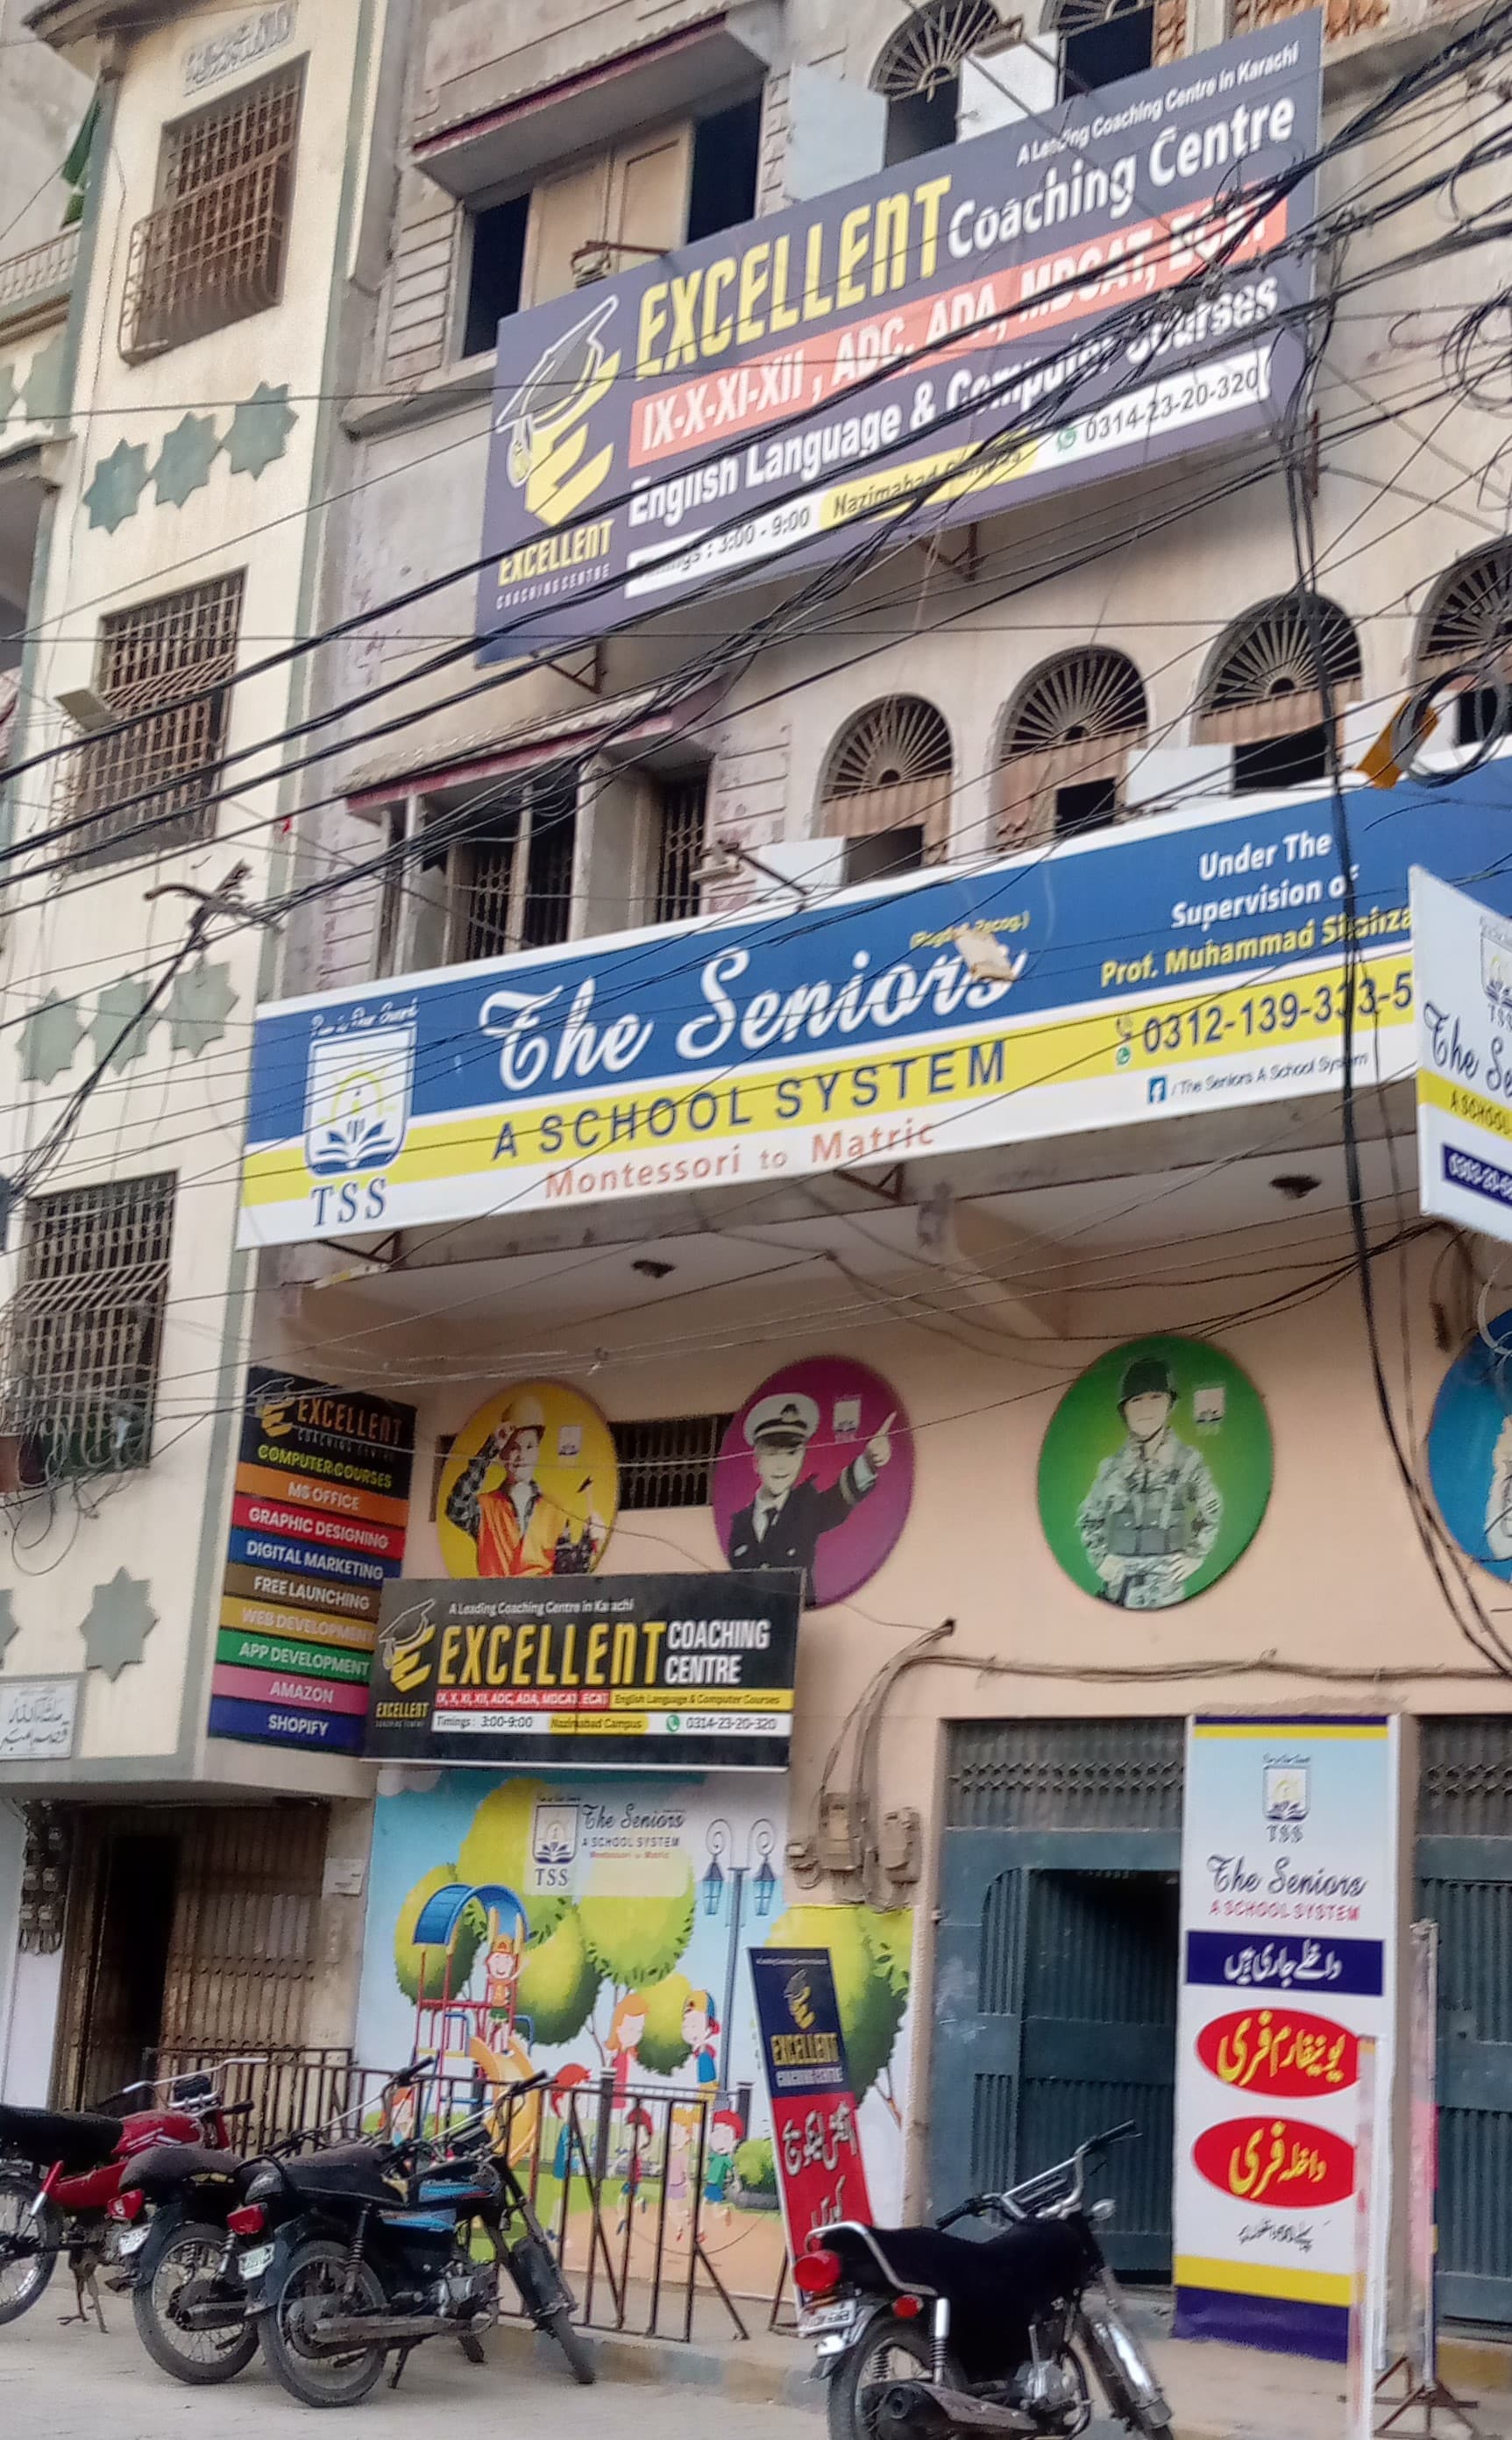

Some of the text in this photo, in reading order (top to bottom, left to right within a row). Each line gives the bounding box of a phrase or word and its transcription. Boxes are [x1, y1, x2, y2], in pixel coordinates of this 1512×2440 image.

[1016, 143, 1030, 167] A
[1091, 96, 1164, 139] Coaching
[1165, 77, 1216, 111] Centre
[1217, 67, 1236, 92] in
[1237, 40, 1300, 85] Karachi
[948, 96, 1296, 260] Coaching Centre
[635, 174, 953, 383] EXCELLENT
[1084, 366, 1260, 445] 0314-23-20-320
[628, 455, 739, 529] English
[745, 403, 903, 481] Language
[910, 380, 936, 430] &
[771, 506, 811, 537] 9:00
[498, 517, 614, 587] EXCELLENT
[1198, 830, 1333, 882] Under The
[1170, 877, 1322, 932] Supervision
[1100, 952, 1158, 988] Prof.
[1164, 921, 1317, 974] Muhammad
[479, 976, 655, 1092] The
[492, 1039, 1006, 1163] A SCHOOL SYSTEM
[544, 1117, 935, 1199] Montessori to Matric
[310, 1176, 388, 1228] TSS
[296, 1396, 404, 1446] EXCELLENT
[257, 1444, 393, 1489] COMPUTER COURSES
[287, 1481, 360, 1511] MS OFFICE
[248, 1506, 389, 1550] GRAPHIC DESIGNING
[246, 1539, 384, 1581] DIGITAL MARKETING
[253, 1576, 371, 1611] FREE LAUNCHING
[458, 1602, 496, 1618] Leading
[497, 1600, 544, 1617] Coaching
[545, 1600, 581, 1614] Centre
[437, 1621, 667, 1686] EXCELLENT
[666, 1619, 771, 1652] COACHING
[238, 1641, 370, 1676] APP DEVELOPMENT
[664, 1654, 742, 1685] CENTRE
[269, 1681, 335, 1704] AMAZON
[268, 1713, 330, 1737] SHOPIFY
[582, 1802, 686, 1831] The Seniors
[590, 1836, 634, 1848] SCHOOL
[635, 1836, 681, 1848] SYSTEM
[534, 1867, 569, 1887] TSS
[1206, 1853, 1368, 1898] The Seniors
[1209, 1899, 1361, 1922] A SCHOOL SYSTEM
